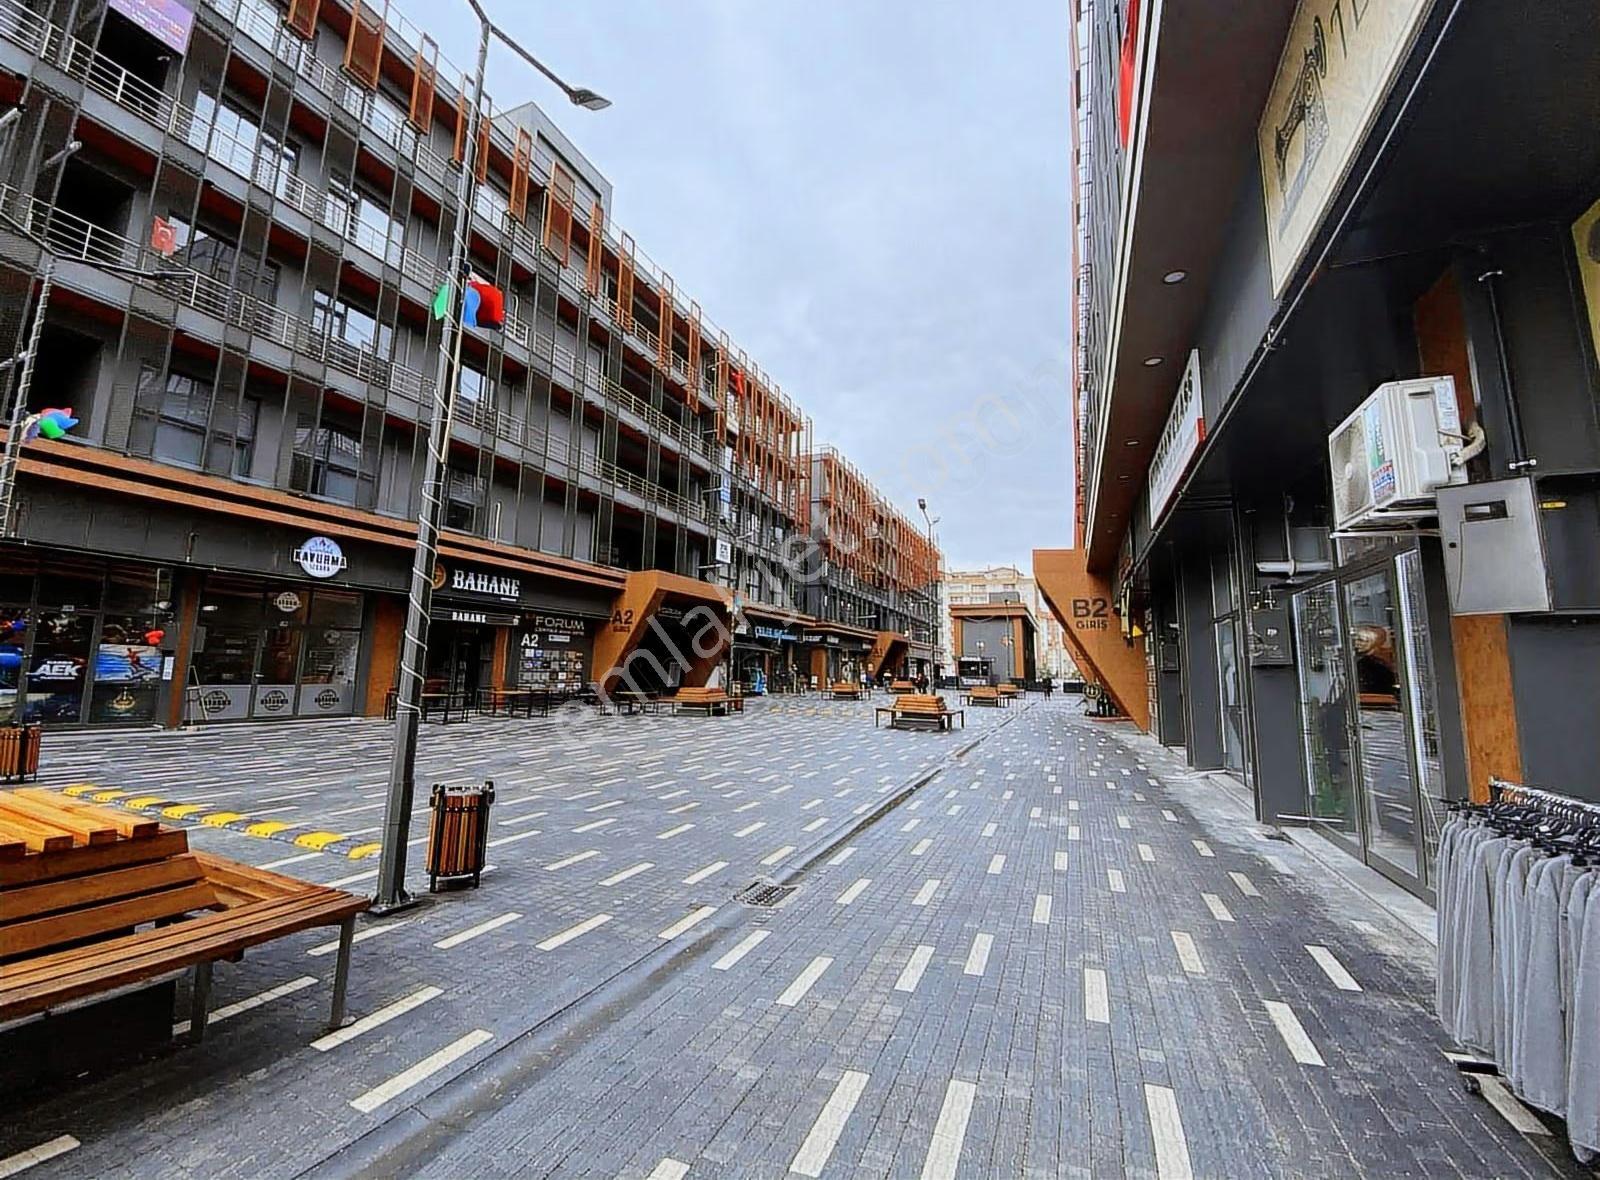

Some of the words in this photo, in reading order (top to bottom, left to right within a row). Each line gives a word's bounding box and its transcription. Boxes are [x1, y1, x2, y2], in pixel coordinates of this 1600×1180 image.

[452, 569, 520, 597] BAHANE
[1072, 597, 1109, 618] B2
[535, 615, 585, 631] FORUM
[611, 608, 634, 626] A2
[520, 633, 539, 648] A2
